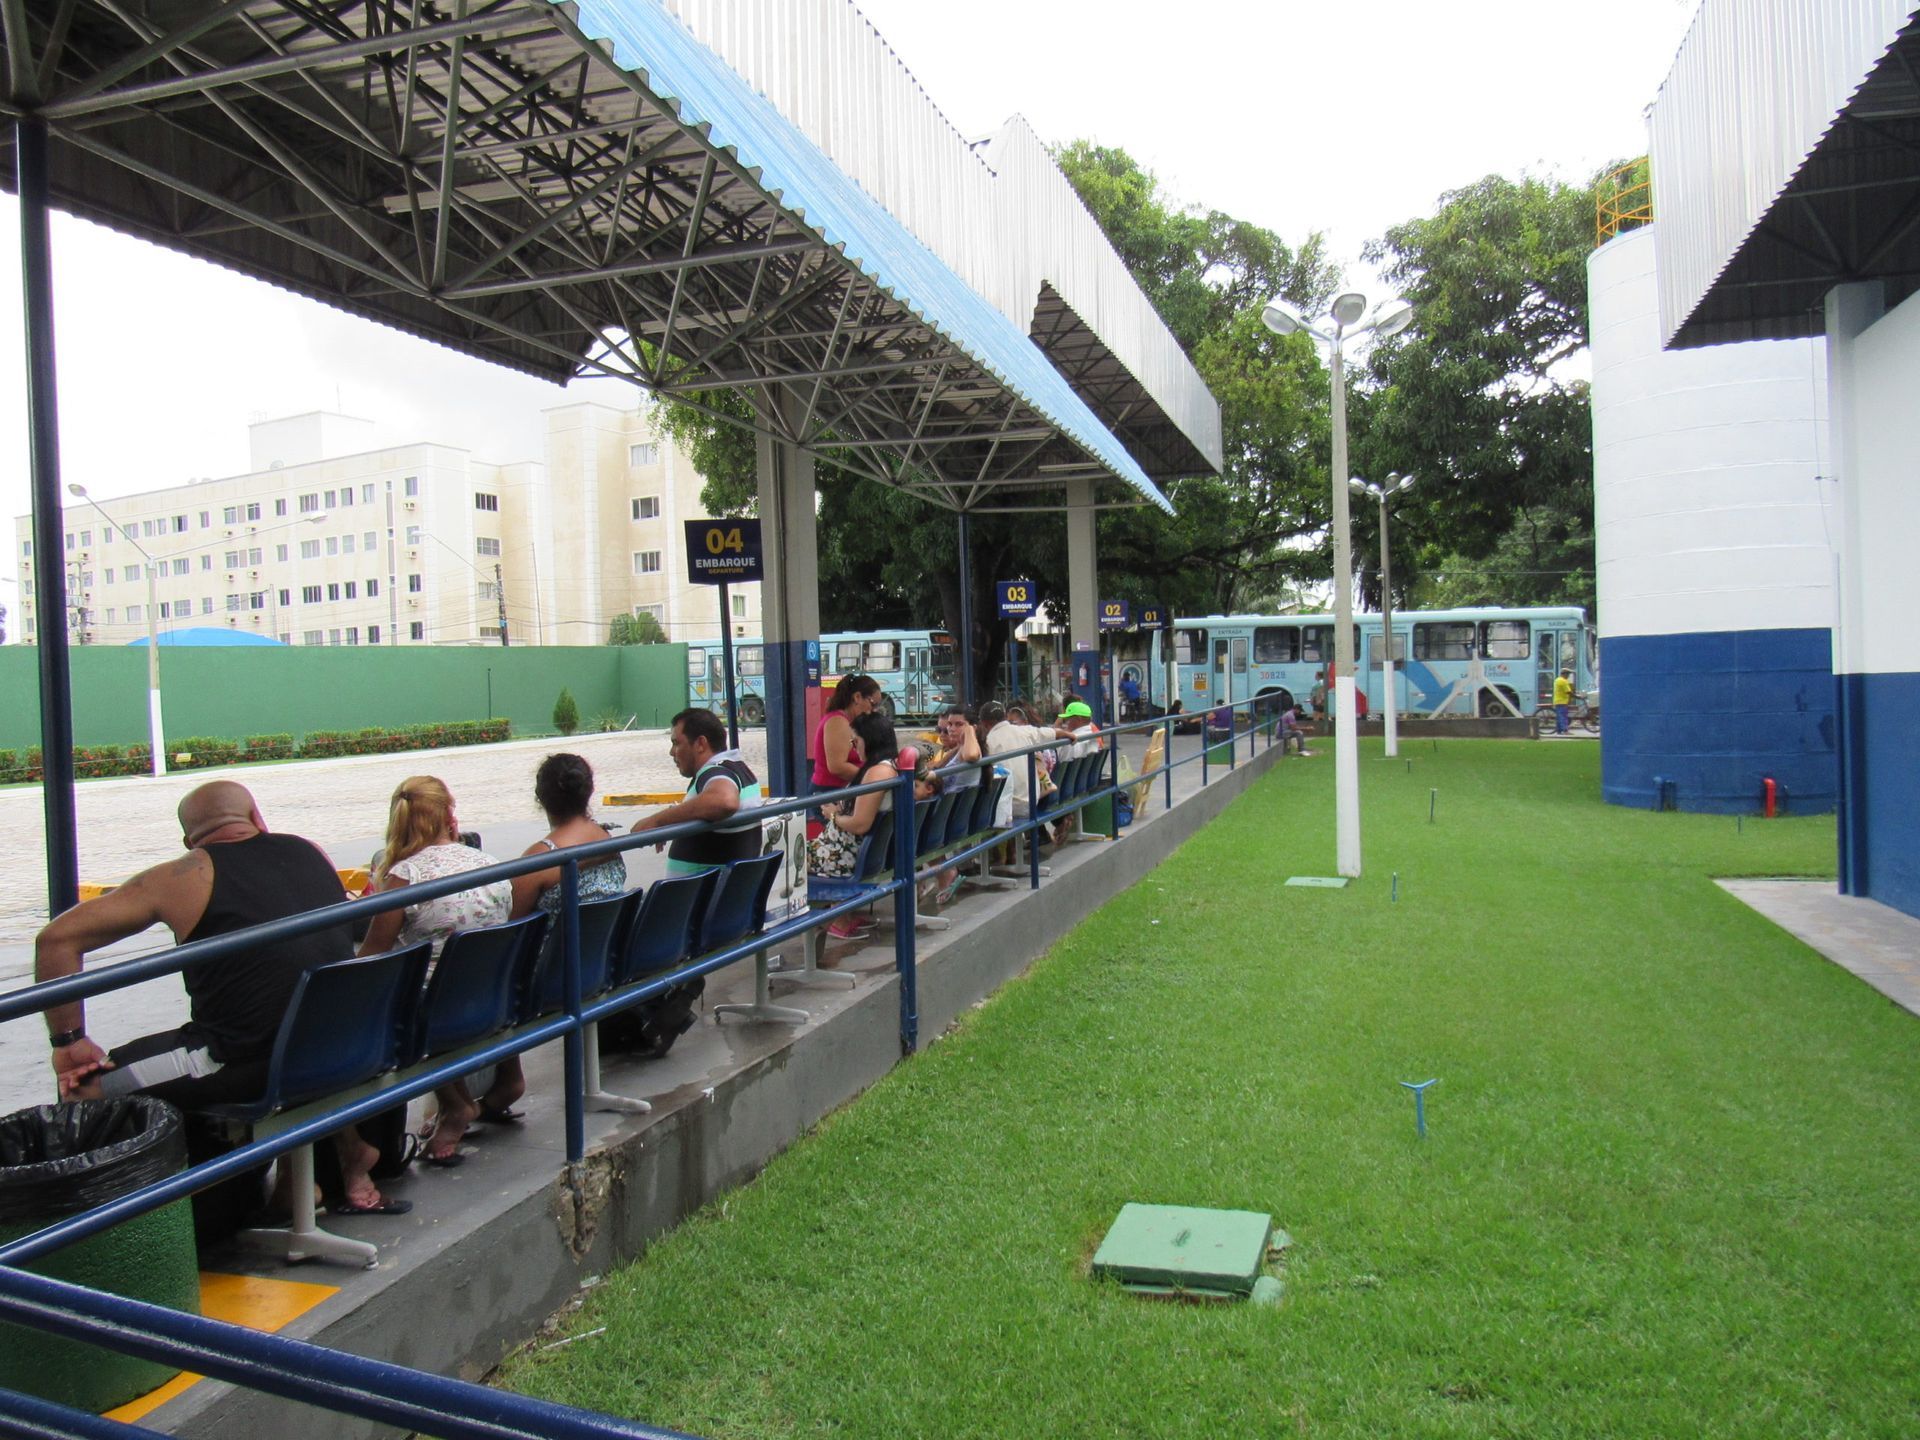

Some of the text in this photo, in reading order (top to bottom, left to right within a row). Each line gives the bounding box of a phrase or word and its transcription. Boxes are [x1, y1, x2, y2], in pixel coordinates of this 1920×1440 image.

[706, 528, 744, 554] 04
[695, 557, 756, 569] EMBARQUE
[1007, 587, 1027, 602] 03
[1105, 604, 1121, 616] 02
[1144, 611, 1157, 621] 01
